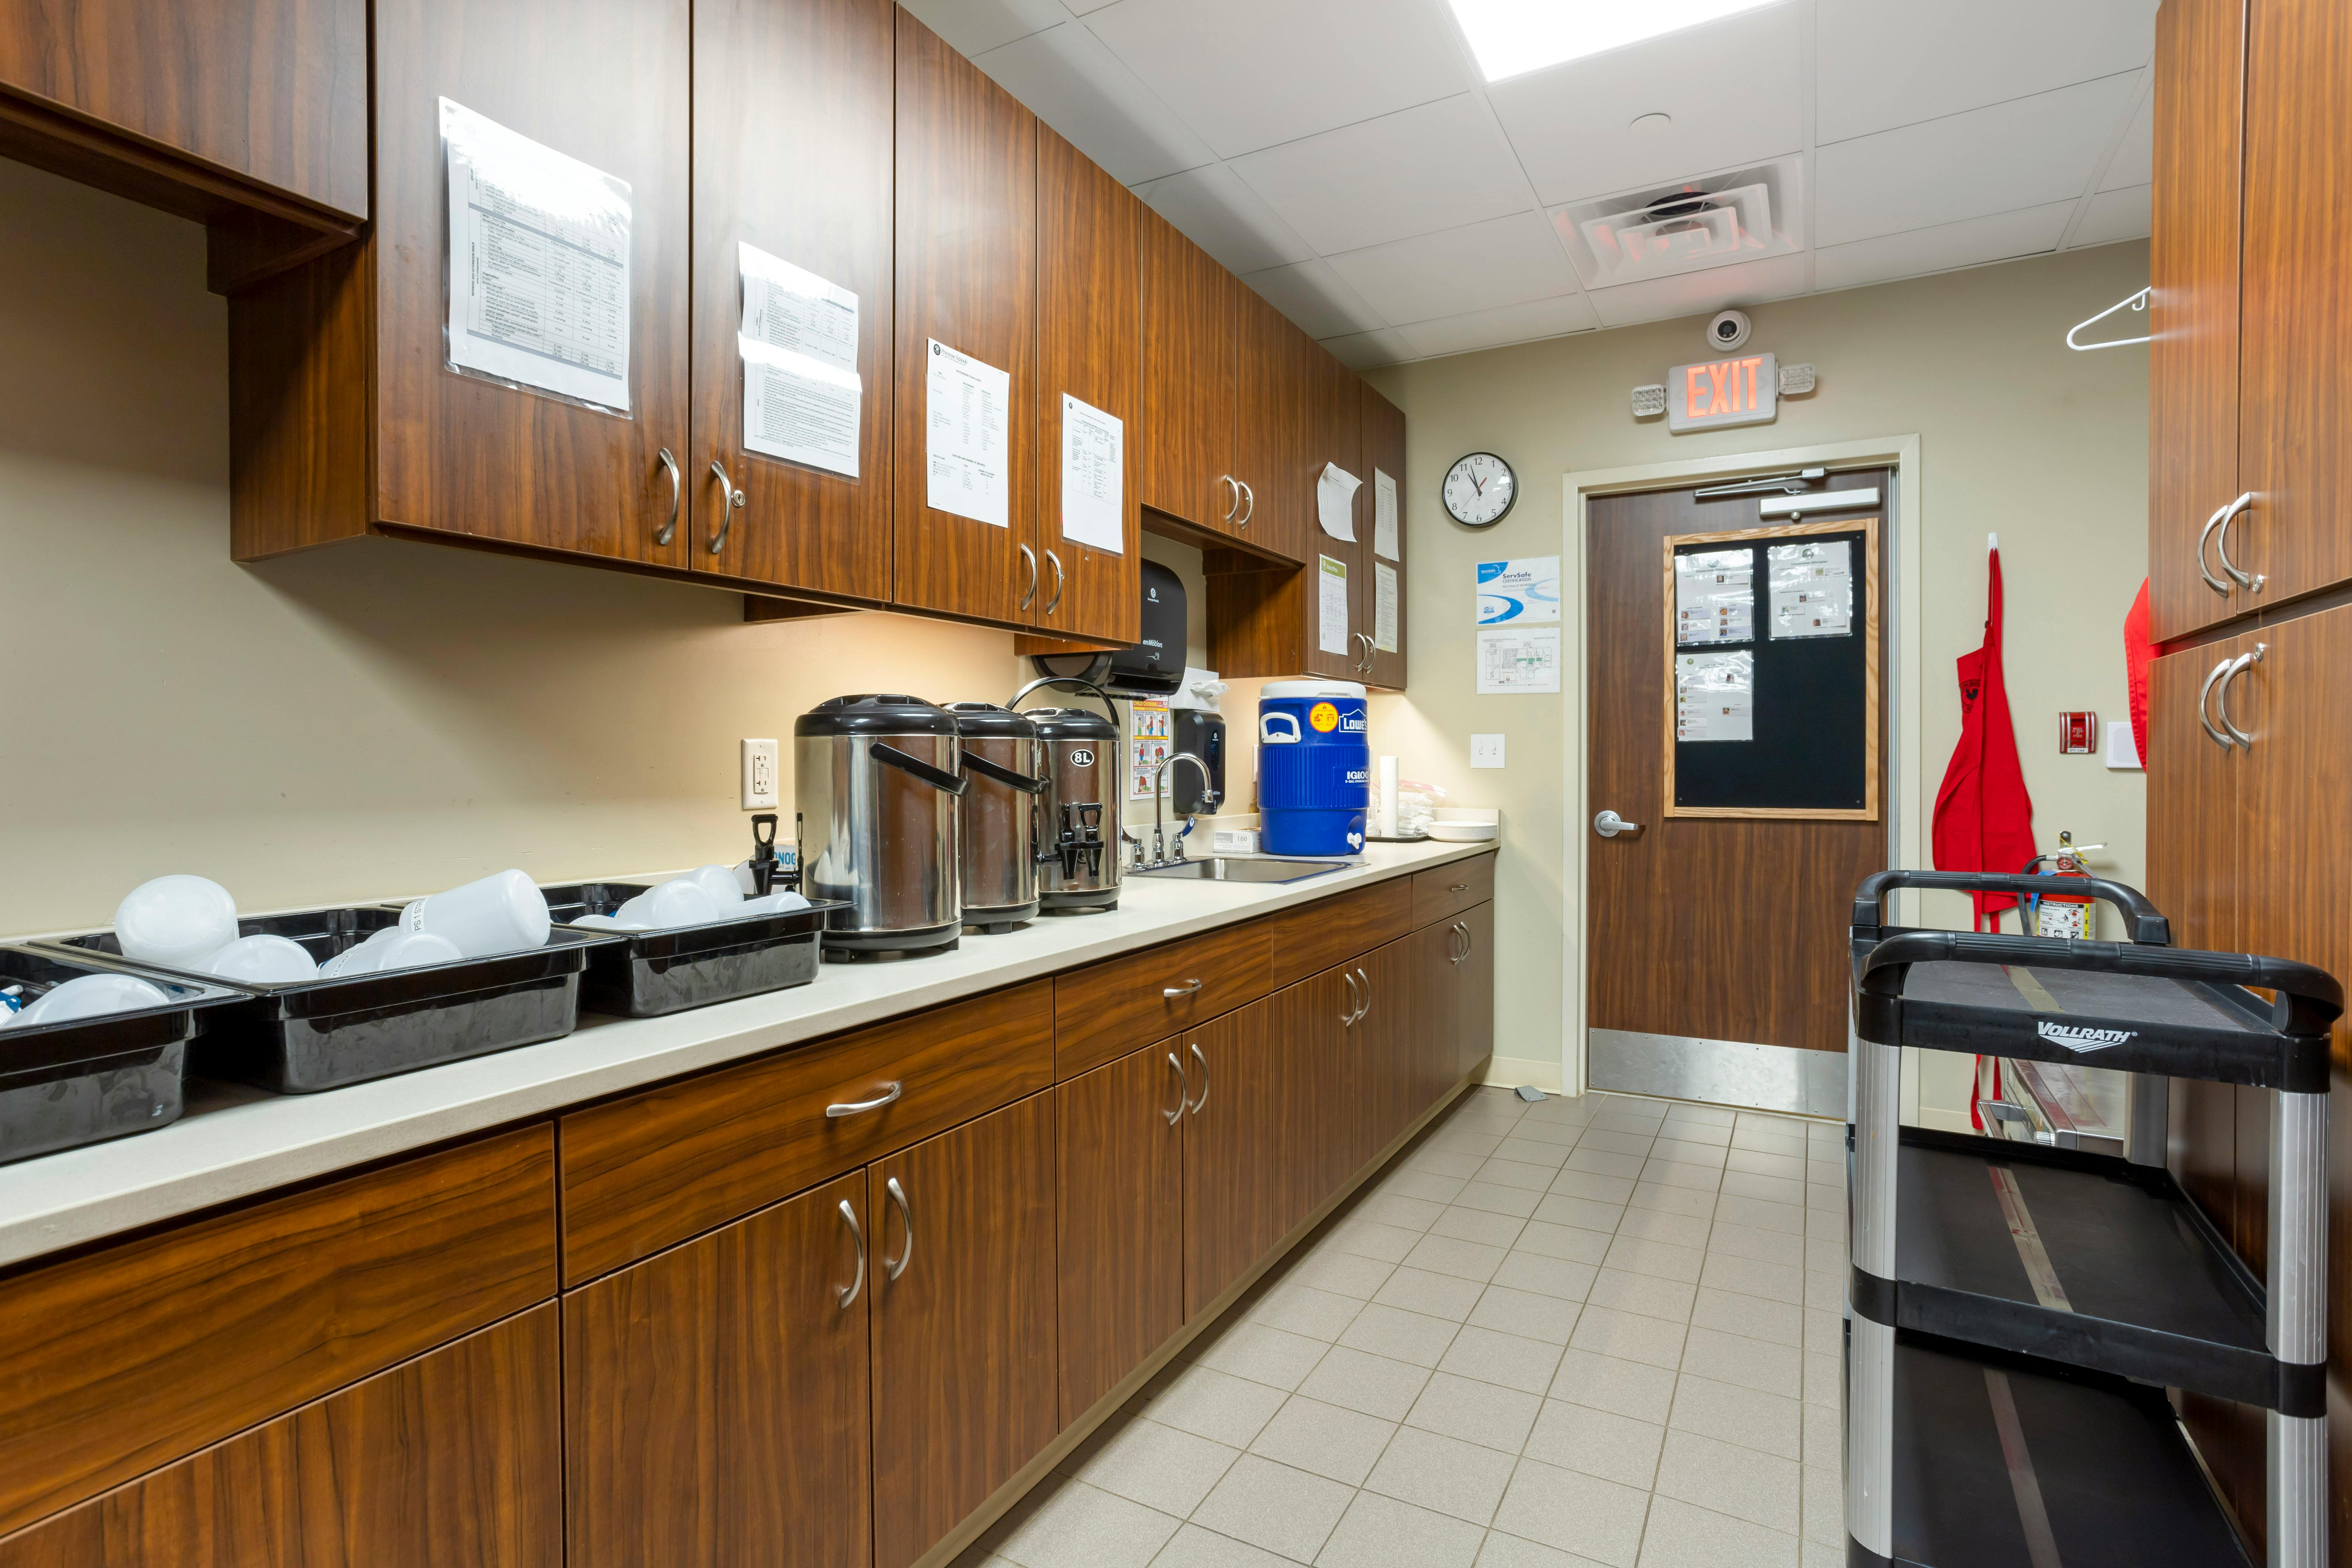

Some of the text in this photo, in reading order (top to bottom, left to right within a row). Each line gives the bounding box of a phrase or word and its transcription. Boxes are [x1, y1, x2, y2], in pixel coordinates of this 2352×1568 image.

[941, 348, 955, 359] Primrose
[956, 355, 968, 364] Schools
[1687, 357, 1761, 418] EXIT
[1143, 639, 1162, 648] enMotion
[1343, 717, 1367, 730] LOWE'S
[1074, 752, 1090, 763] 8L
[1347, 771, 1368, 779] IGLOO
[414, 899, 425, 915] STRO
[414, 920, 421, 931] PS
[2038, 1021, 2131, 1043] VOLLRATH
